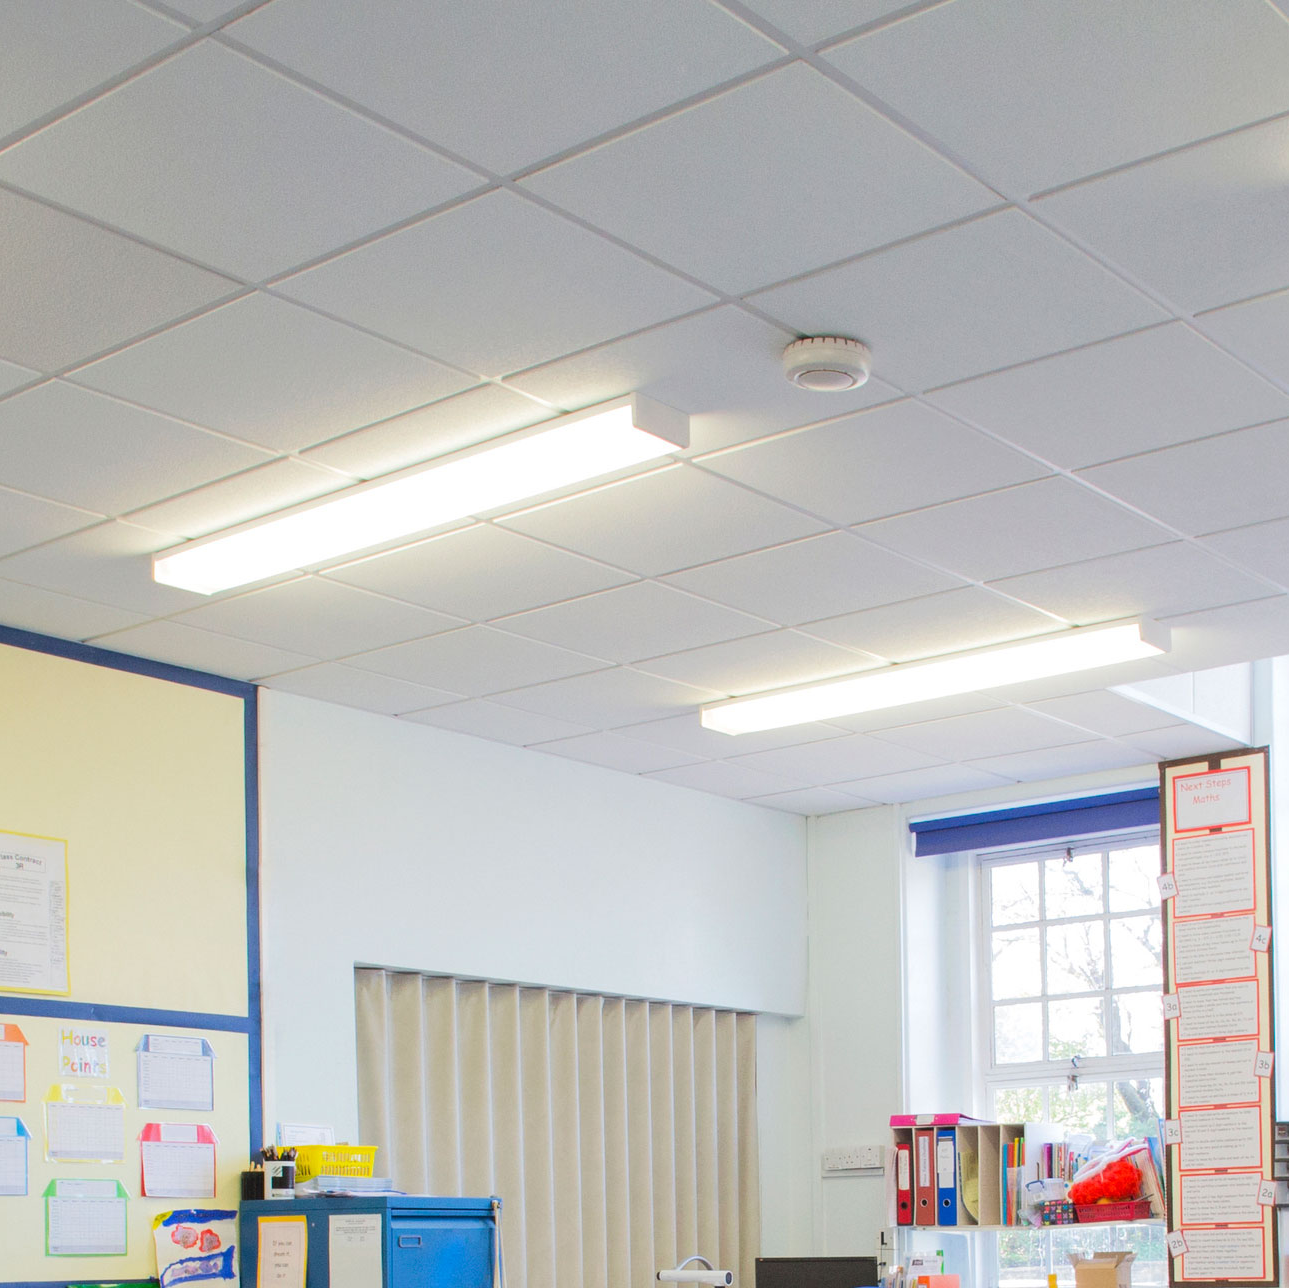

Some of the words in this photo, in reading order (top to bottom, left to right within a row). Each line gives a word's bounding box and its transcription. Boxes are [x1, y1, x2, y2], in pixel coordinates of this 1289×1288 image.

[1180, 782, 1202, 792] Next
[1205, 778, 1232, 790] Steps
[1192, 794, 1221, 805] Maths
[15, 853, 42, 866] Contract
[1162, 882, 1174, 891] 4b
[1255, 934, 1267, 945] 4c
[1166, 1002, 1178, 1012] 3a
[61, 1029, 106, 1047] House
[62, 1055, 107, 1075] Points
[1258, 1060, 1270, 1070] 3b
[1168, 1128, 1179, 1137] 3c
[1261, 1188, 1273, 1198] 2a
[1171, 1239, 1184, 1249] 2b
